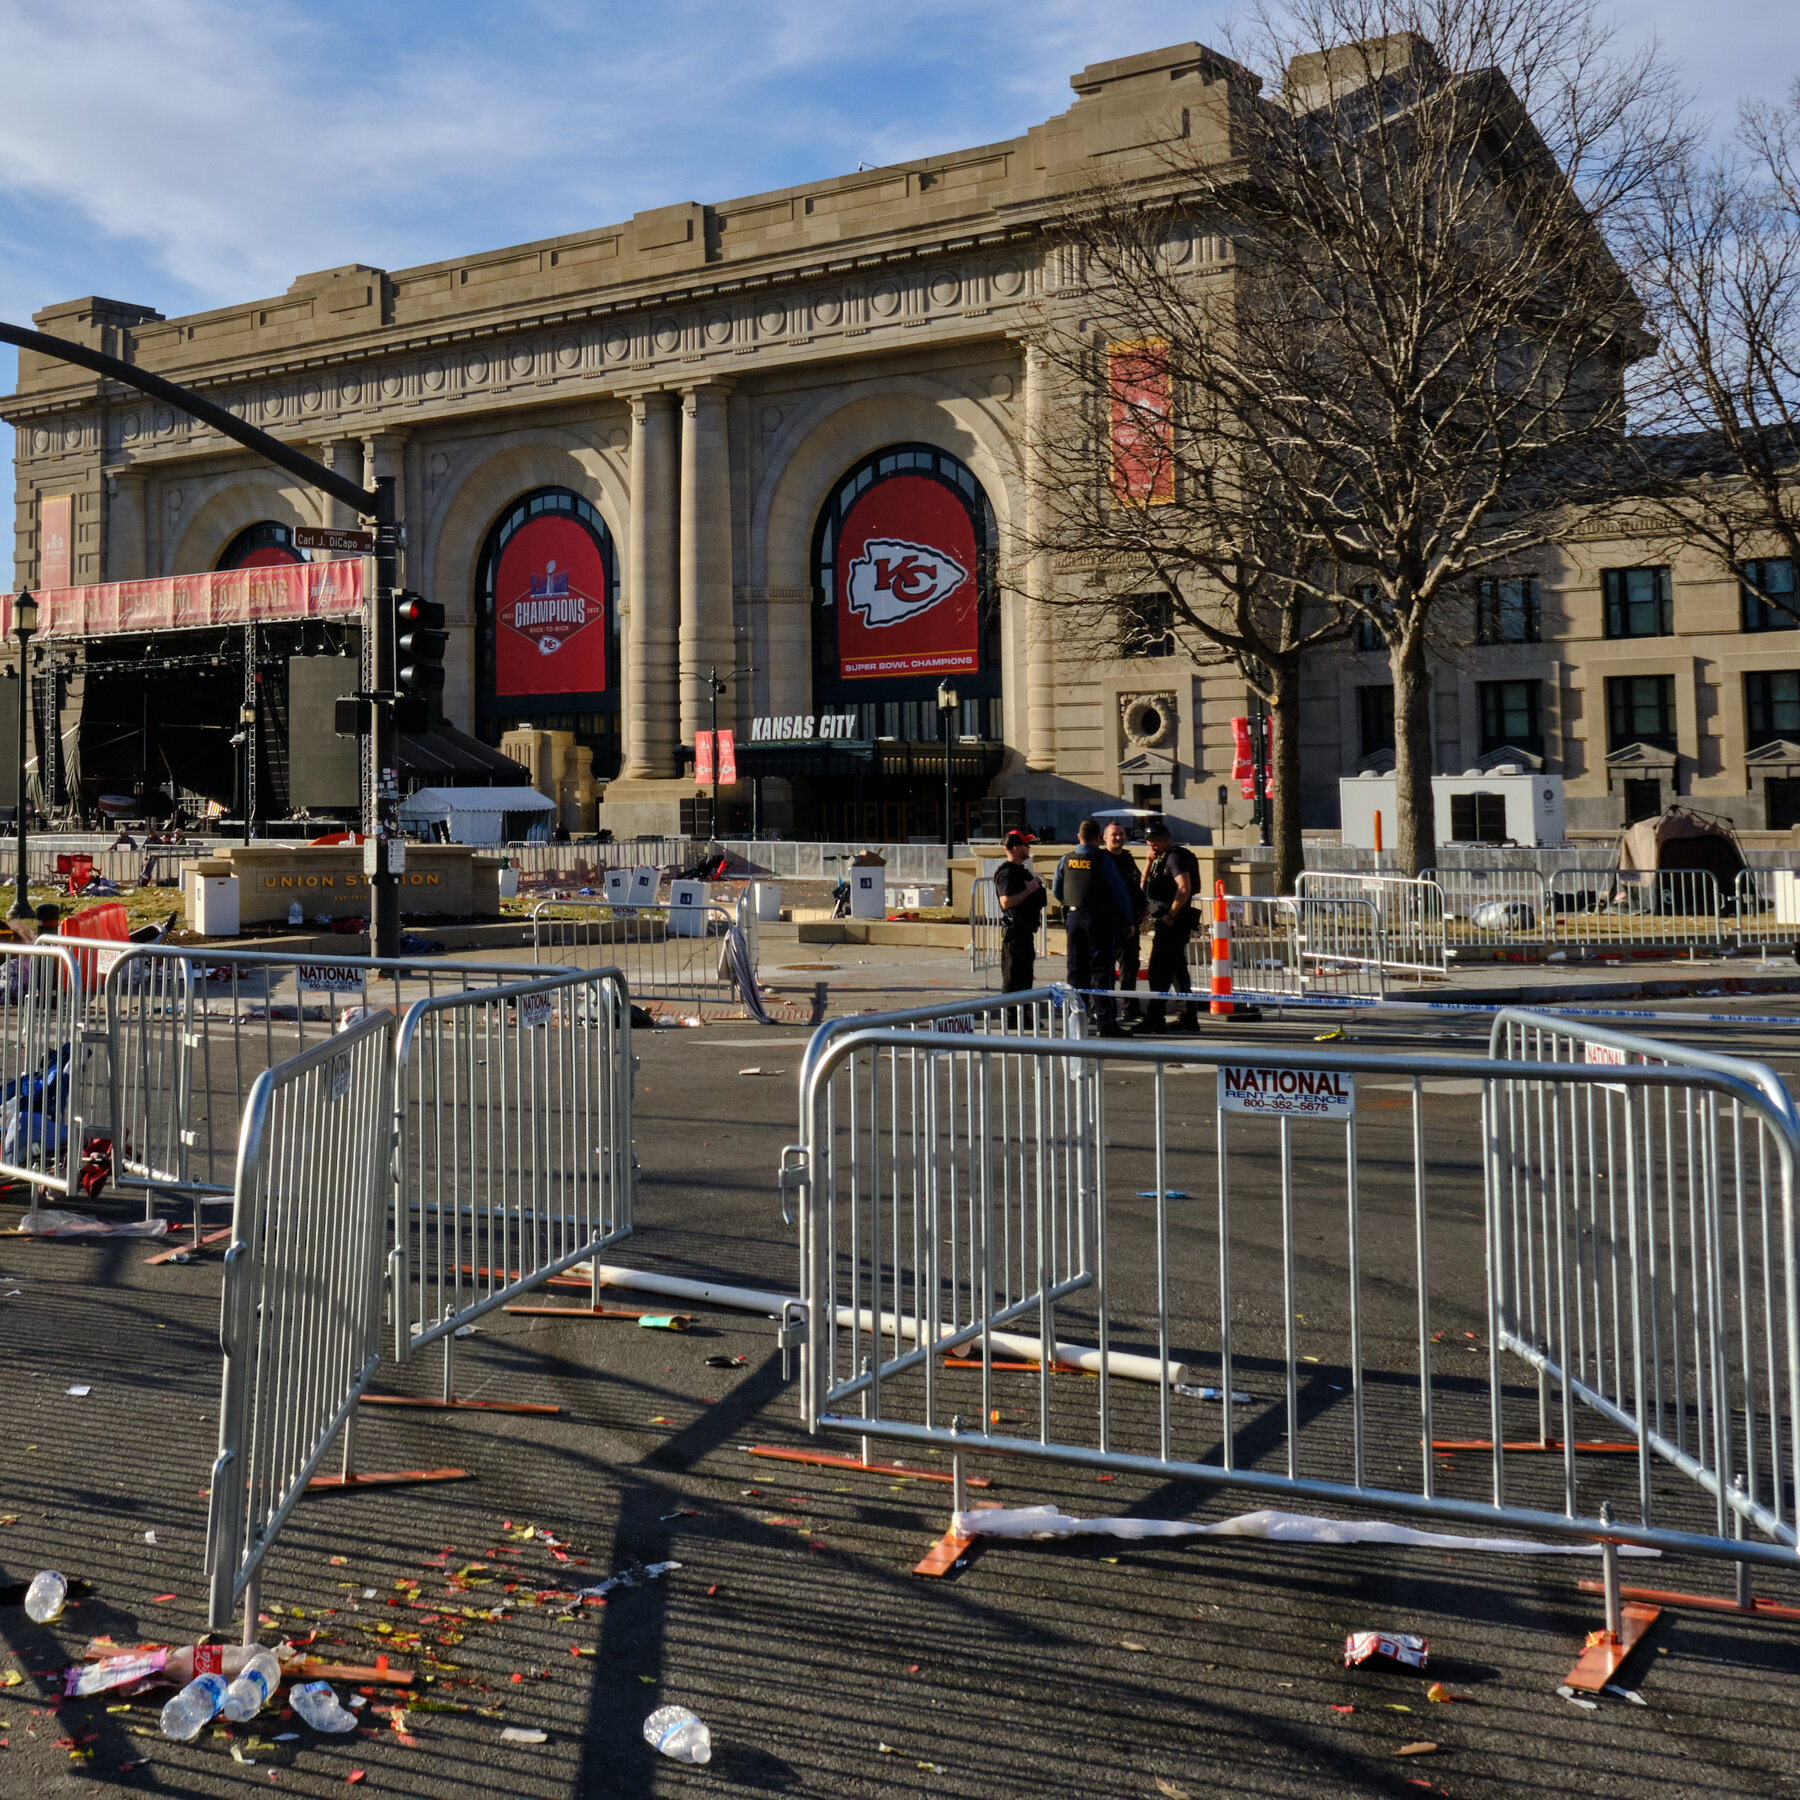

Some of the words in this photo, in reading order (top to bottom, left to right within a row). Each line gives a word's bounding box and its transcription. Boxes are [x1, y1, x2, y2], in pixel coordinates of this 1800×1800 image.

[298, 534, 315, 545] Carl
[318, 536, 326, 546] J.
[329, 537, 358, 549] DiCapo
[874, 555, 938, 602] KC
[515, 598, 585, 628] CHAMPIONS
[845, 662, 877, 672] SUPER
[879, 660, 909, 670] BOWL
[911, 656, 973, 667] CHAMPIONS
[751, 715, 815, 741] KANSAS
[819, 714, 857, 739] CITY
[1068, 859, 1091, 869] POLICE
[265, 876, 334, 888] UNION
[299, 966, 363, 982] NATIONAL
[937, 1015, 974, 1033] NATIONAL
[1225, 1067, 1349, 1097] NATIONAL
[1225, 1090, 1348, 1105] RENT-A-FENCE
[1243, 1098, 1329, 1112] 800-352-5675
